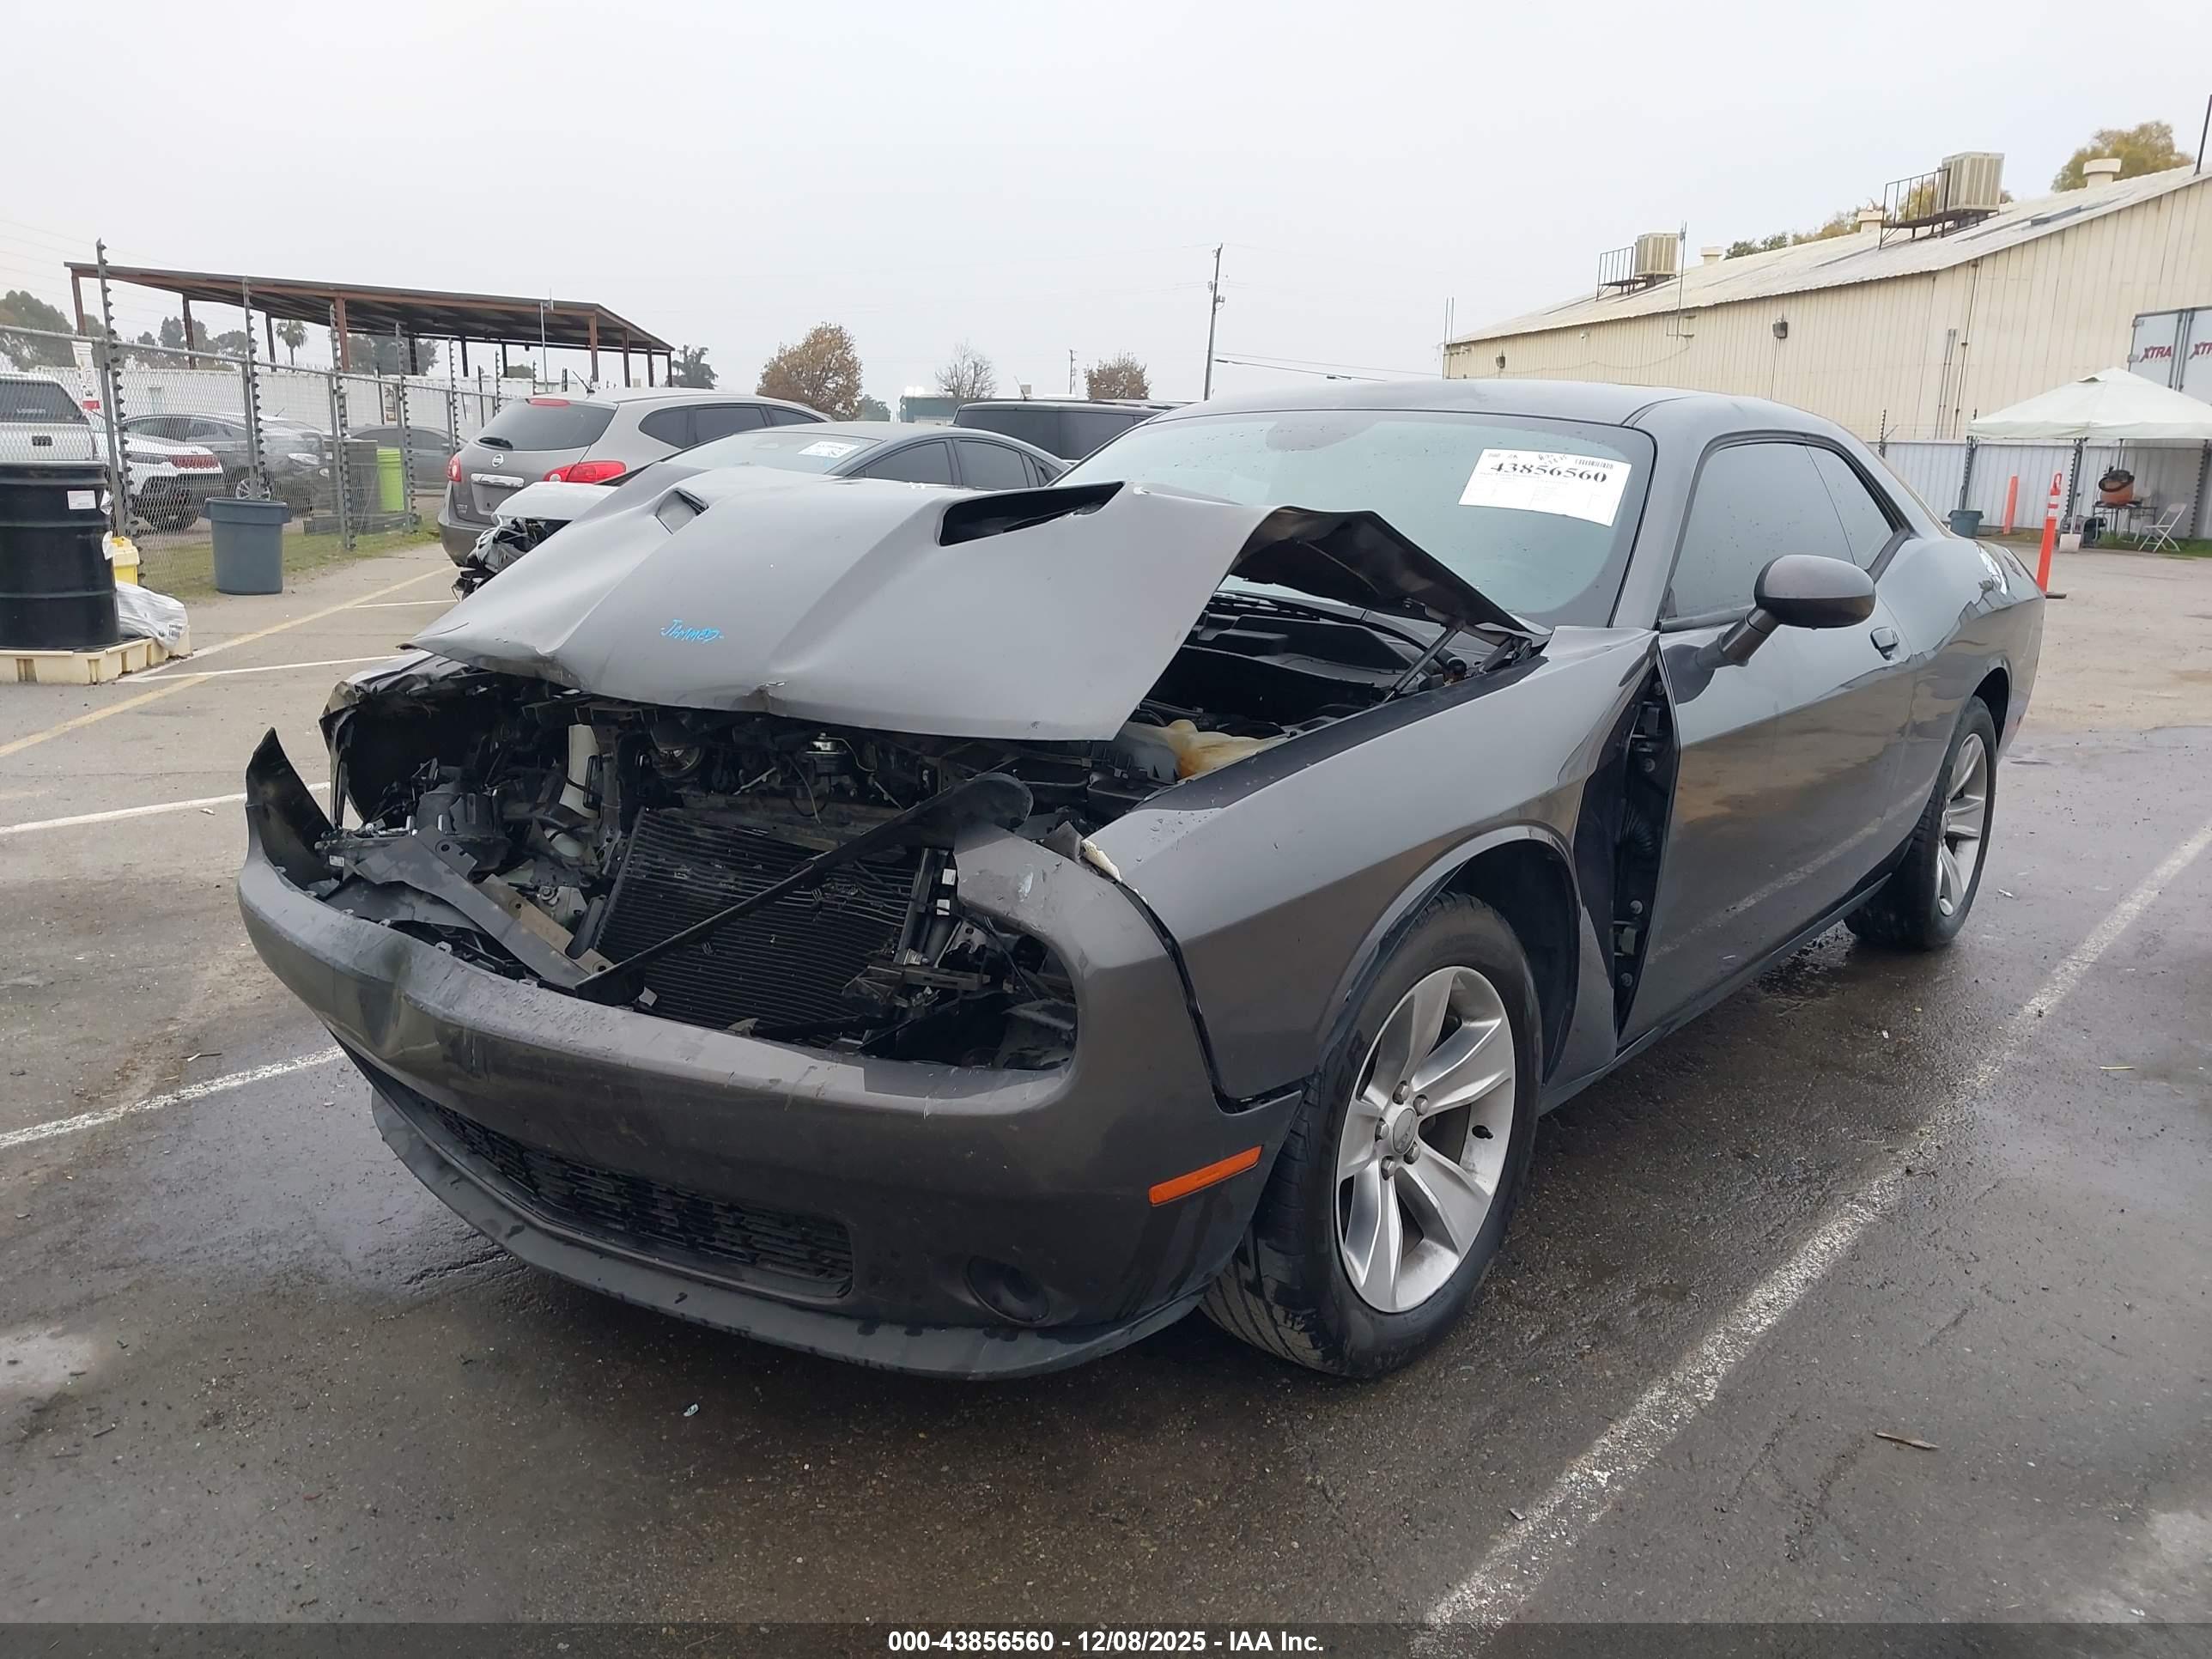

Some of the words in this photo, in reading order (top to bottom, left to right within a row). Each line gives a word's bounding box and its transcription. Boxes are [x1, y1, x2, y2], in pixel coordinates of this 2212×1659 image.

[2139, 345, 2172, 362] XTRA
[2188, 341, 2212, 360] XTR
[1490, 462, 1607, 483] 43856560
